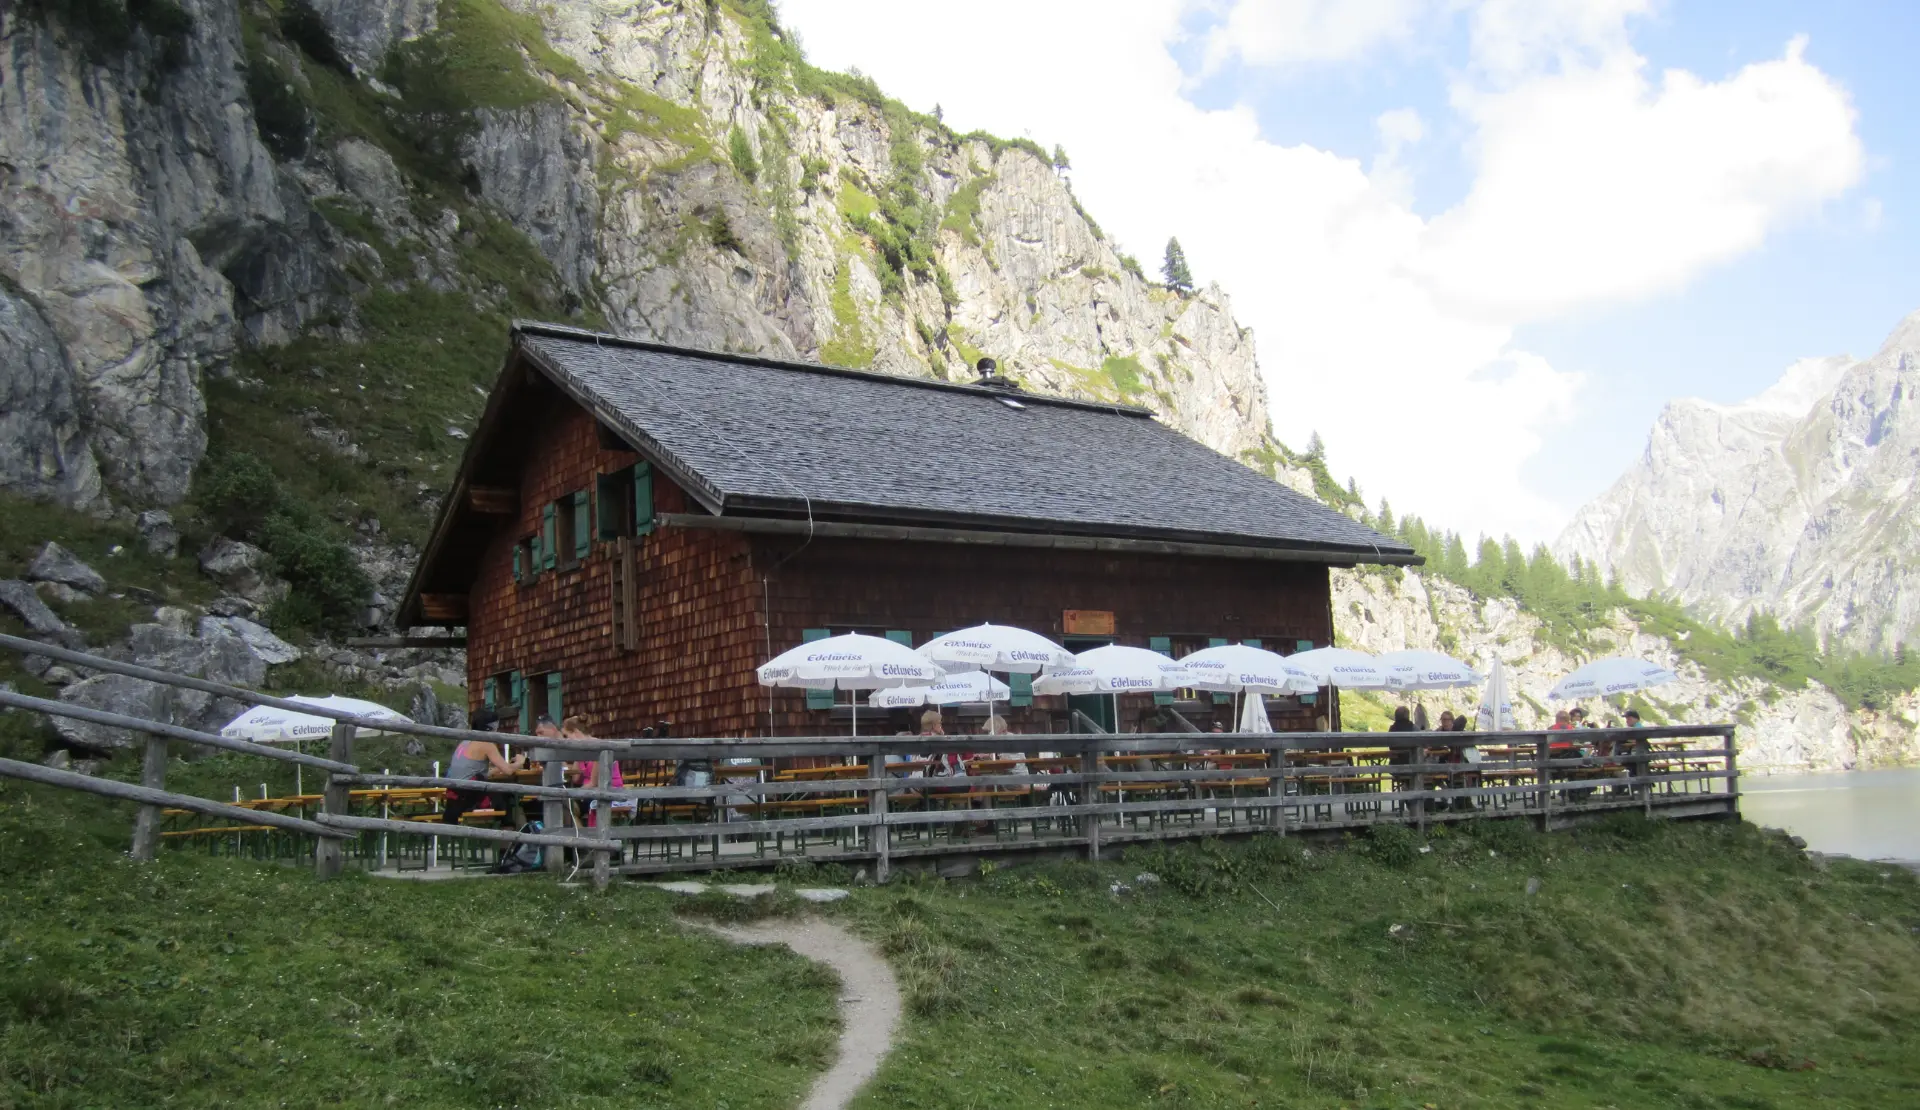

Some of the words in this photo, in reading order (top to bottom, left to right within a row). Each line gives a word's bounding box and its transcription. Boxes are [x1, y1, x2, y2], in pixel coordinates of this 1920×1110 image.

[807, 653, 863, 662] Edelweiss
[1011, 651, 1050, 662] Edelweiss
[1184, 660, 1226, 669] Edelweiss
[764, 667, 790, 680] Edelweiss
[882, 664, 923, 677] Edelweiss
[1052, 669, 1096, 678] Edelweiss
[1333, 666, 1376, 674] Edelweiss
[1240, 673, 1278, 685] Edelweiss
[1428, 672, 1462, 681] Edelweiss
[930, 682, 973, 691] Edelweiss
[1111, 677, 1153, 688] Edelweiss
[1606, 681, 1639, 692] Edelweiss
[887, 695, 916, 705] Edelweiss
[292, 724, 332, 736] Edelweiss
